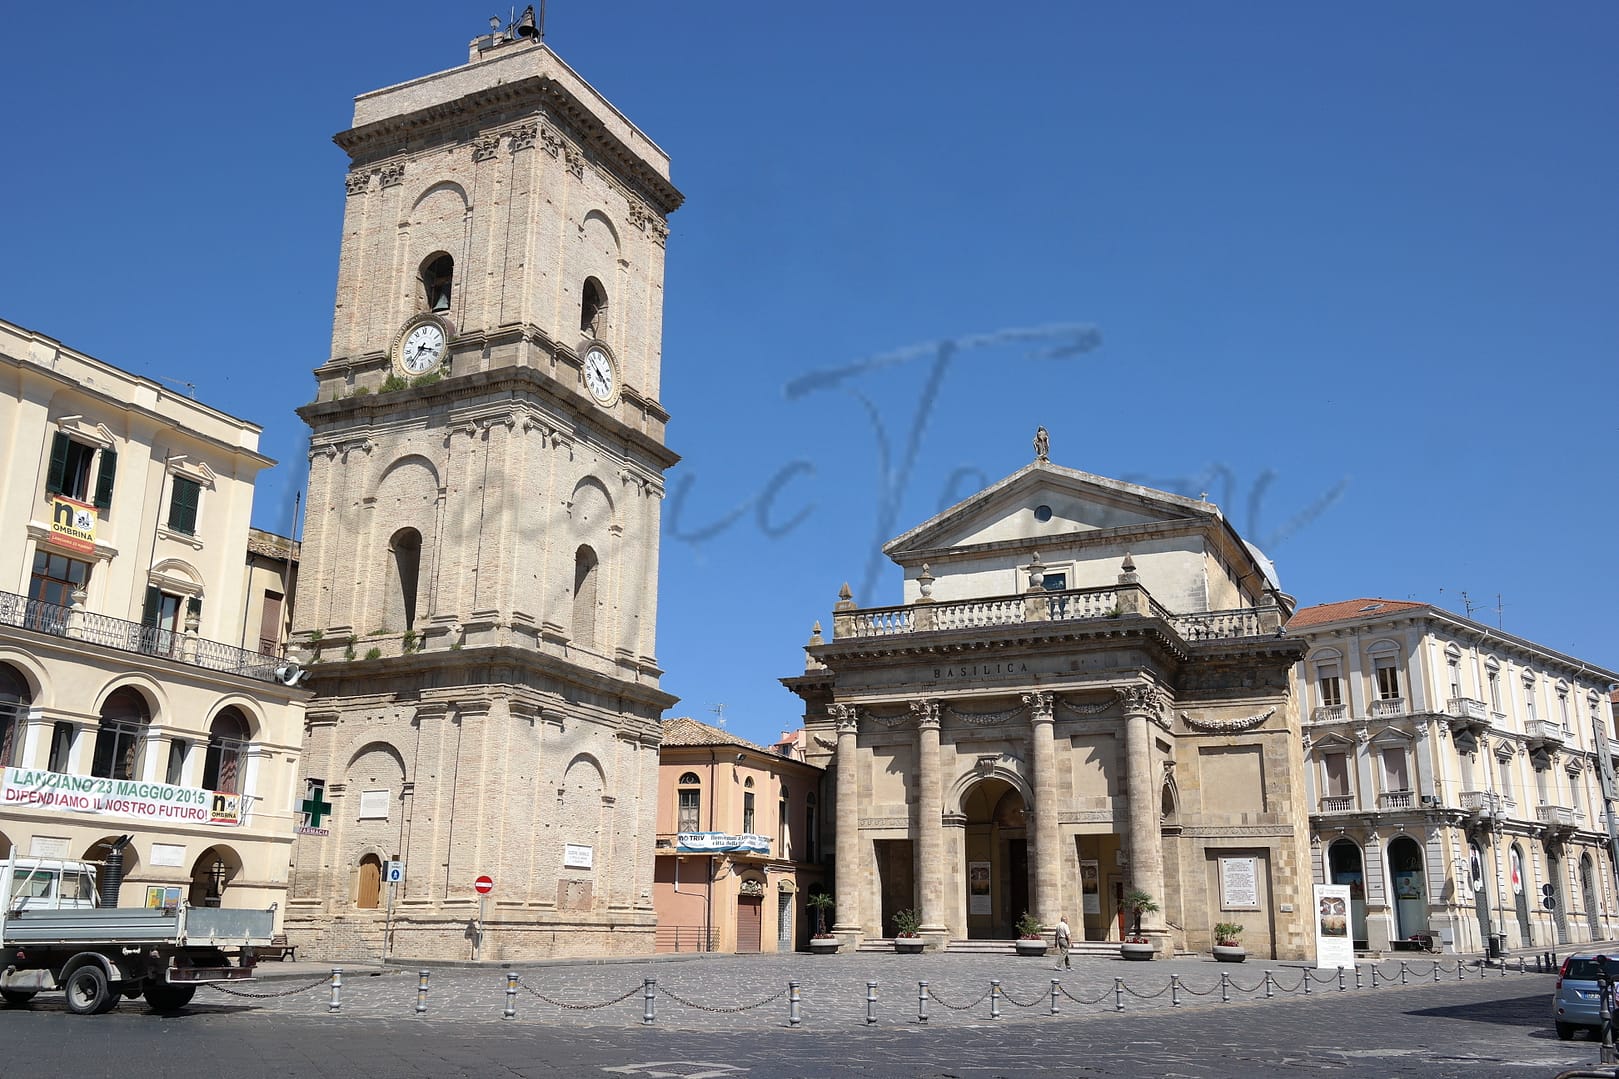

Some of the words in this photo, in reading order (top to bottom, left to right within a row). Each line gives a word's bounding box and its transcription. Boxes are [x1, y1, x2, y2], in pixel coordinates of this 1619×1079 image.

[53, 524, 93, 541] OMBRINA
[934, 663, 1028, 678] BASILICA
[13, 769, 93, 792] LANCIANO
[97, 780, 113, 794] 23
[117, 781, 173, 801] MAGGIO
[176, 789, 205, 804] 2015
[6, 788, 89, 809] DIFENDIAMO
[94, 798, 102, 810] IL
[105, 799, 156, 815] NOSTRO
[159, 805, 208, 820] FUTURO!
